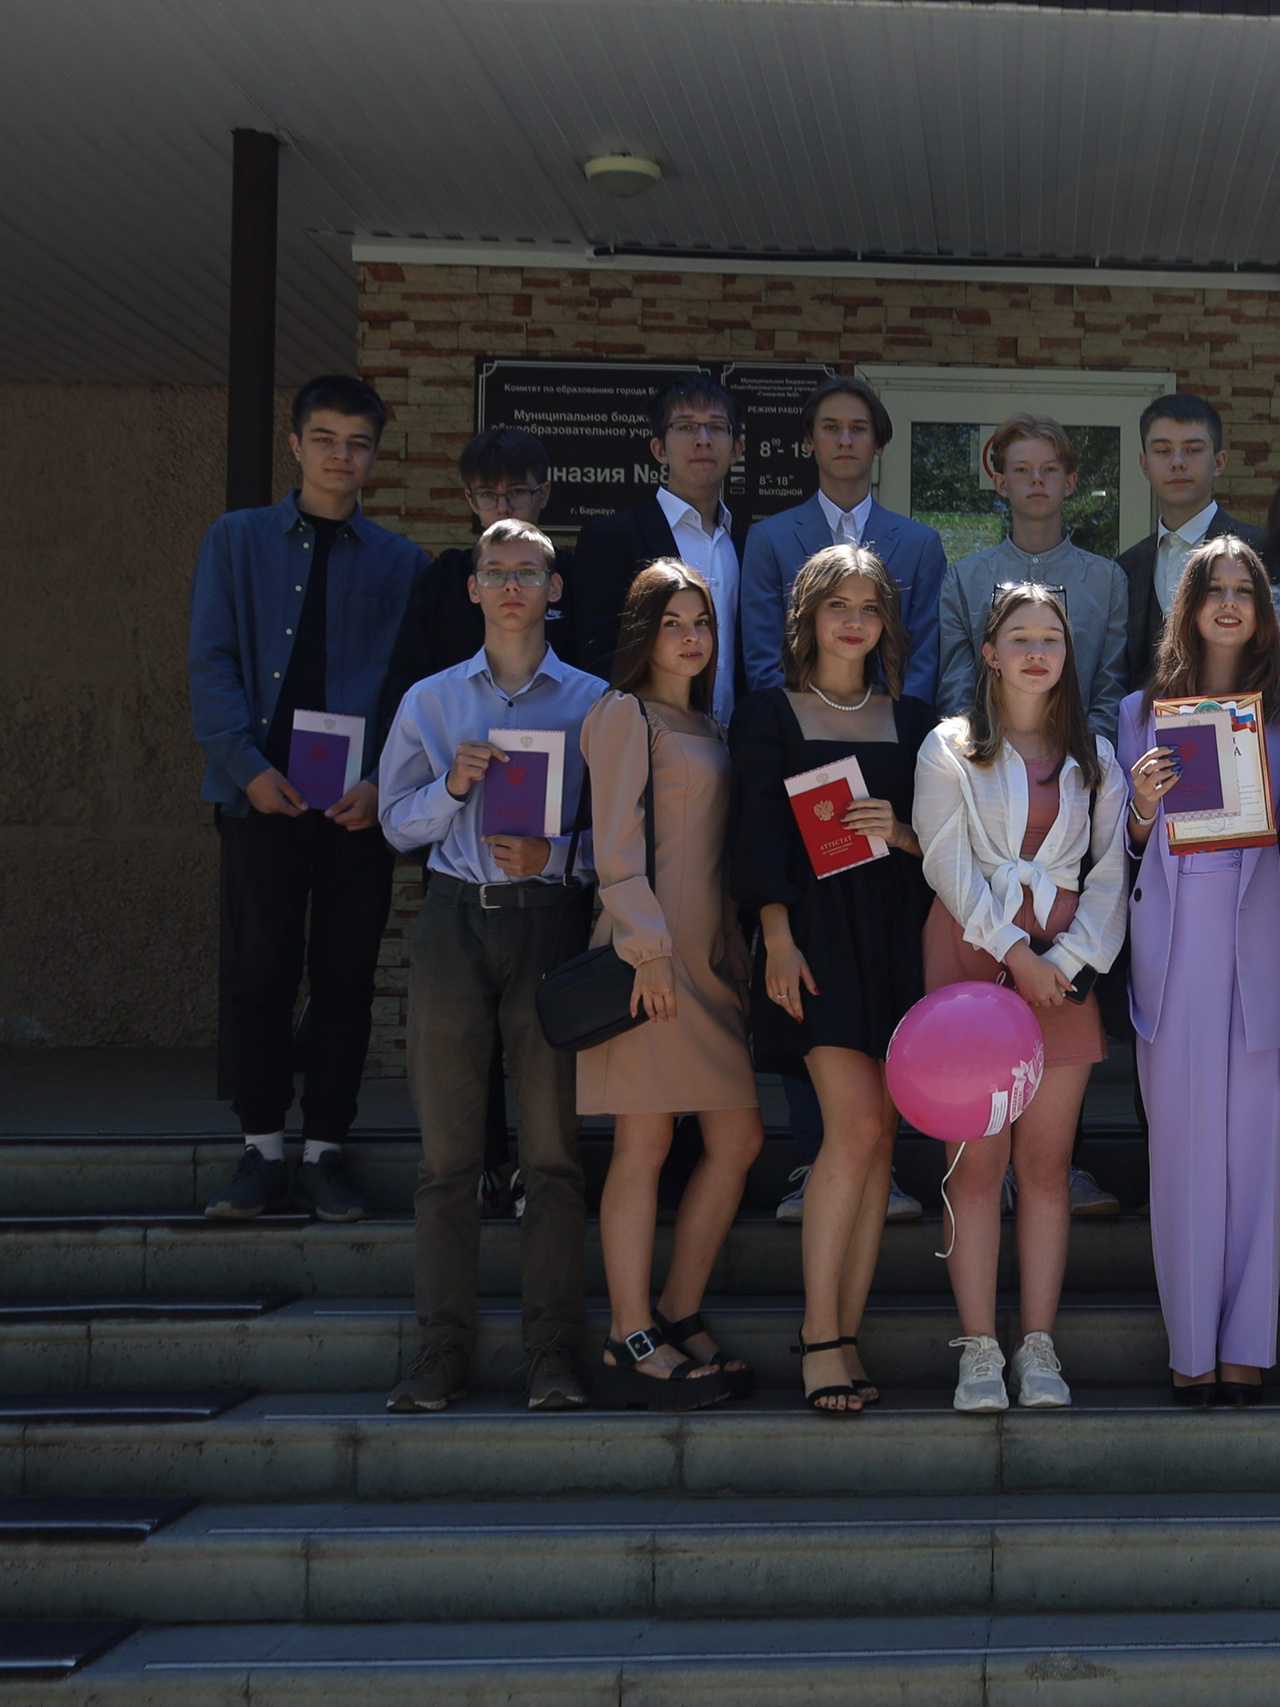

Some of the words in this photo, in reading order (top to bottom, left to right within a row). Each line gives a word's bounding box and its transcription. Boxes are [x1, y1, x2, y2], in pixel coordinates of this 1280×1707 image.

[504, 383, 541, 393] Комитет
[543, 386, 554, 394] по
[556, 384, 614, 395] образованию
[616, 386, 646, 397] города
[514, 409, 608, 423] Муниципальное
[611, 411, 650, 424] бюдж
[747, 405, 777, 414] РЕЖИМ
[778, 406, 803, 415] РАБОТ
[629, 427, 653, 440] учр
[547, 466, 625, 483] назия
[758, 488, 803, 497] ВЫХОДНОЙ
[579, 506, 616, 516] Барнаул
[820, 834, 852, 851] АТТЕСТАТ
